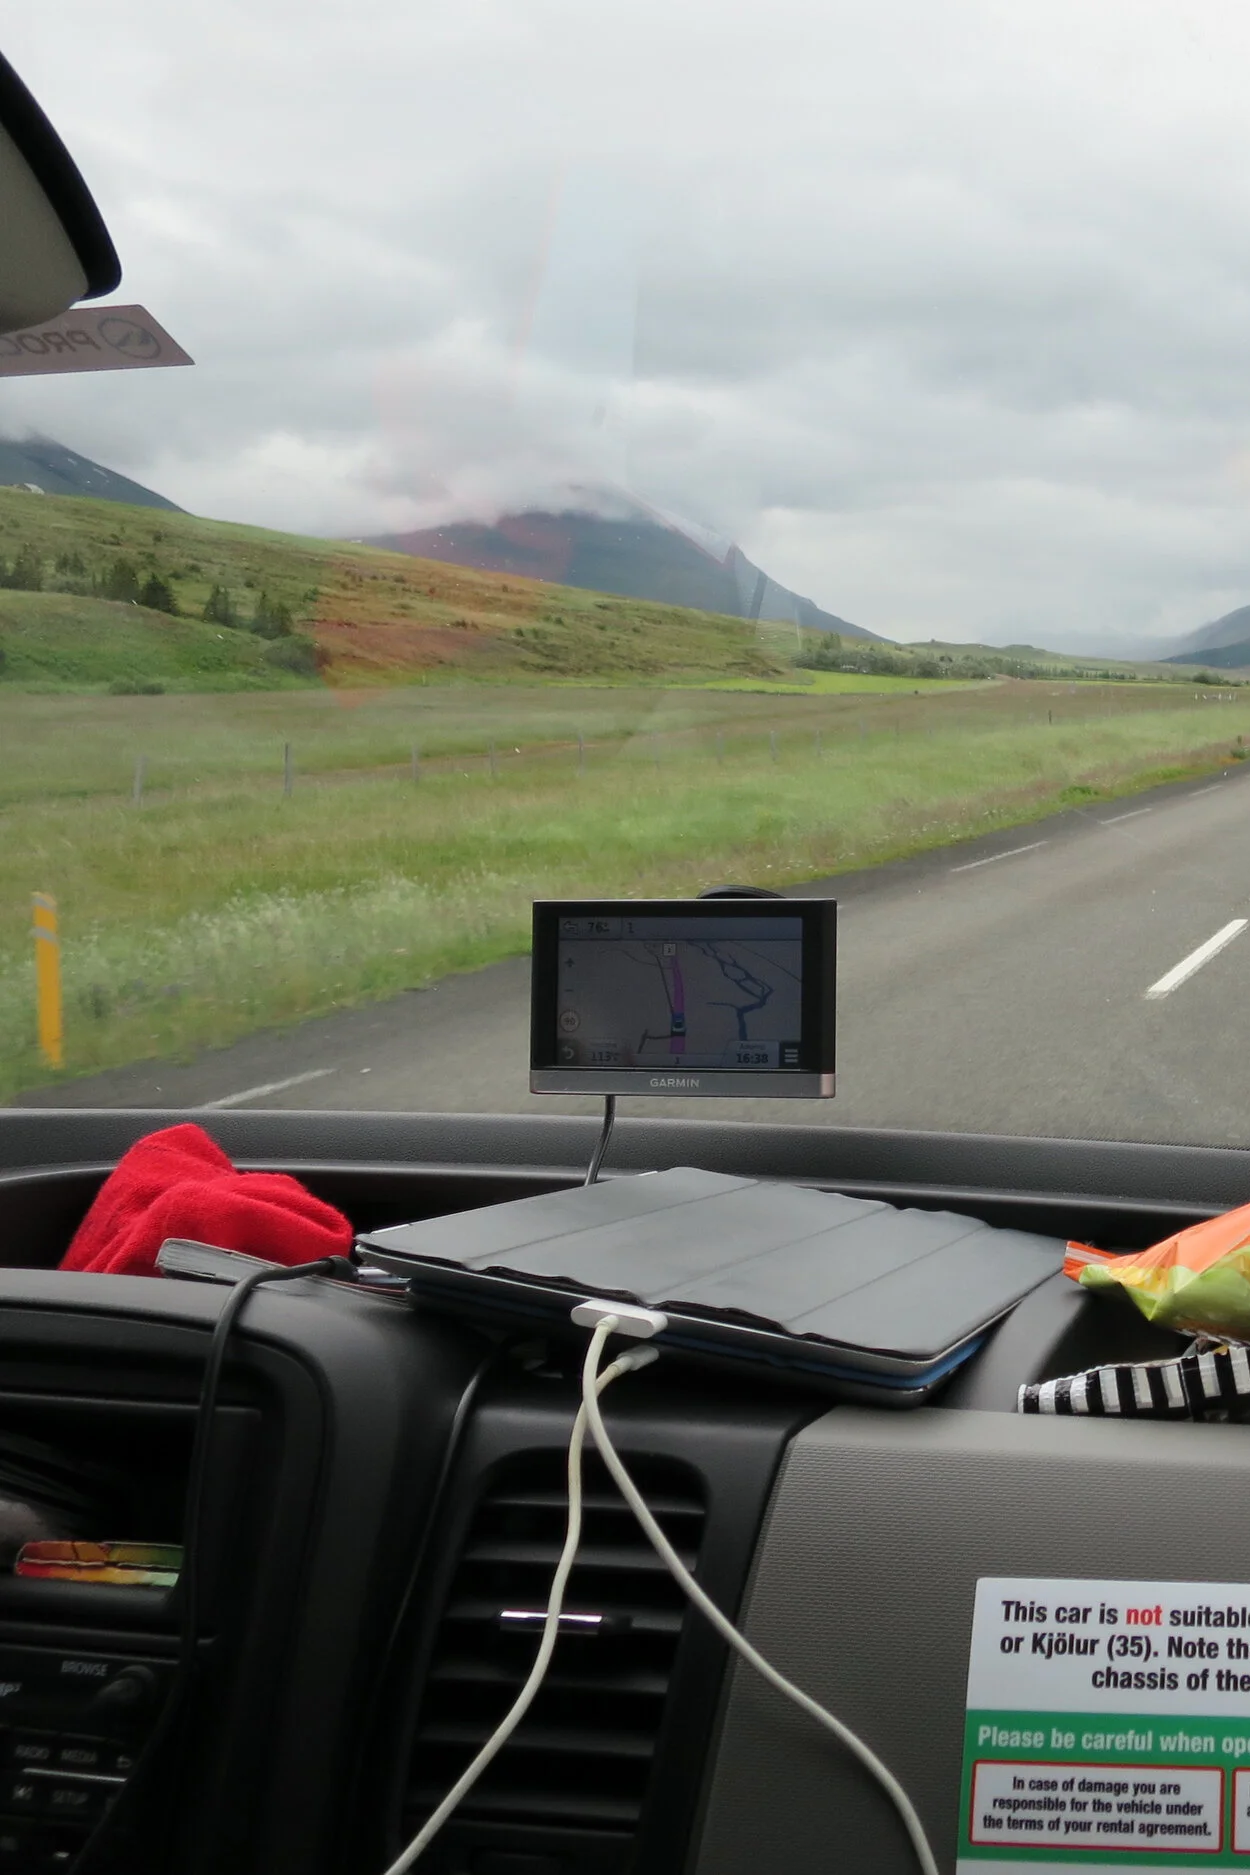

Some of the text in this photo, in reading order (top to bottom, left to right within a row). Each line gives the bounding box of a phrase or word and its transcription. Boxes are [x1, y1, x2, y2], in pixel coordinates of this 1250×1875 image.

[737, 1053, 768, 1064] 16:38
[650, 1078, 699, 1088] GARMIN
[1001, 1600, 1047, 1624] This
[1055, 1606, 1091, 1625] car
[1100, 1604, 1118, 1625] is
[1127, 1607, 1162, 1626] not
[1000, 1637, 1023, 1654] or
[1032, 1634, 1099, 1660] Kjölur
[1107, 1636, 1159, 1661] (35).
[1168, 1637, 1219, 1658] Note
[61, 1661, 108, 1676] BROWSE
[1092, 1668, 1179, 1690] chassis
[1187, 1669, 1209, 1691] of
[978, 1726, 1044, 1748] Please
[1051, 1729, 1075, 1749] be
[1082, 1729, 1153, 1751] careful
[1160, 1732, 1214, 1752] when
[1013, 1777, 1181, 1797] In case of damage you are
[993, 1797, 1203, 1816] responsible for the vehicle under
[983, 1816, 1211, 1838] the terms of your rental agreement.
